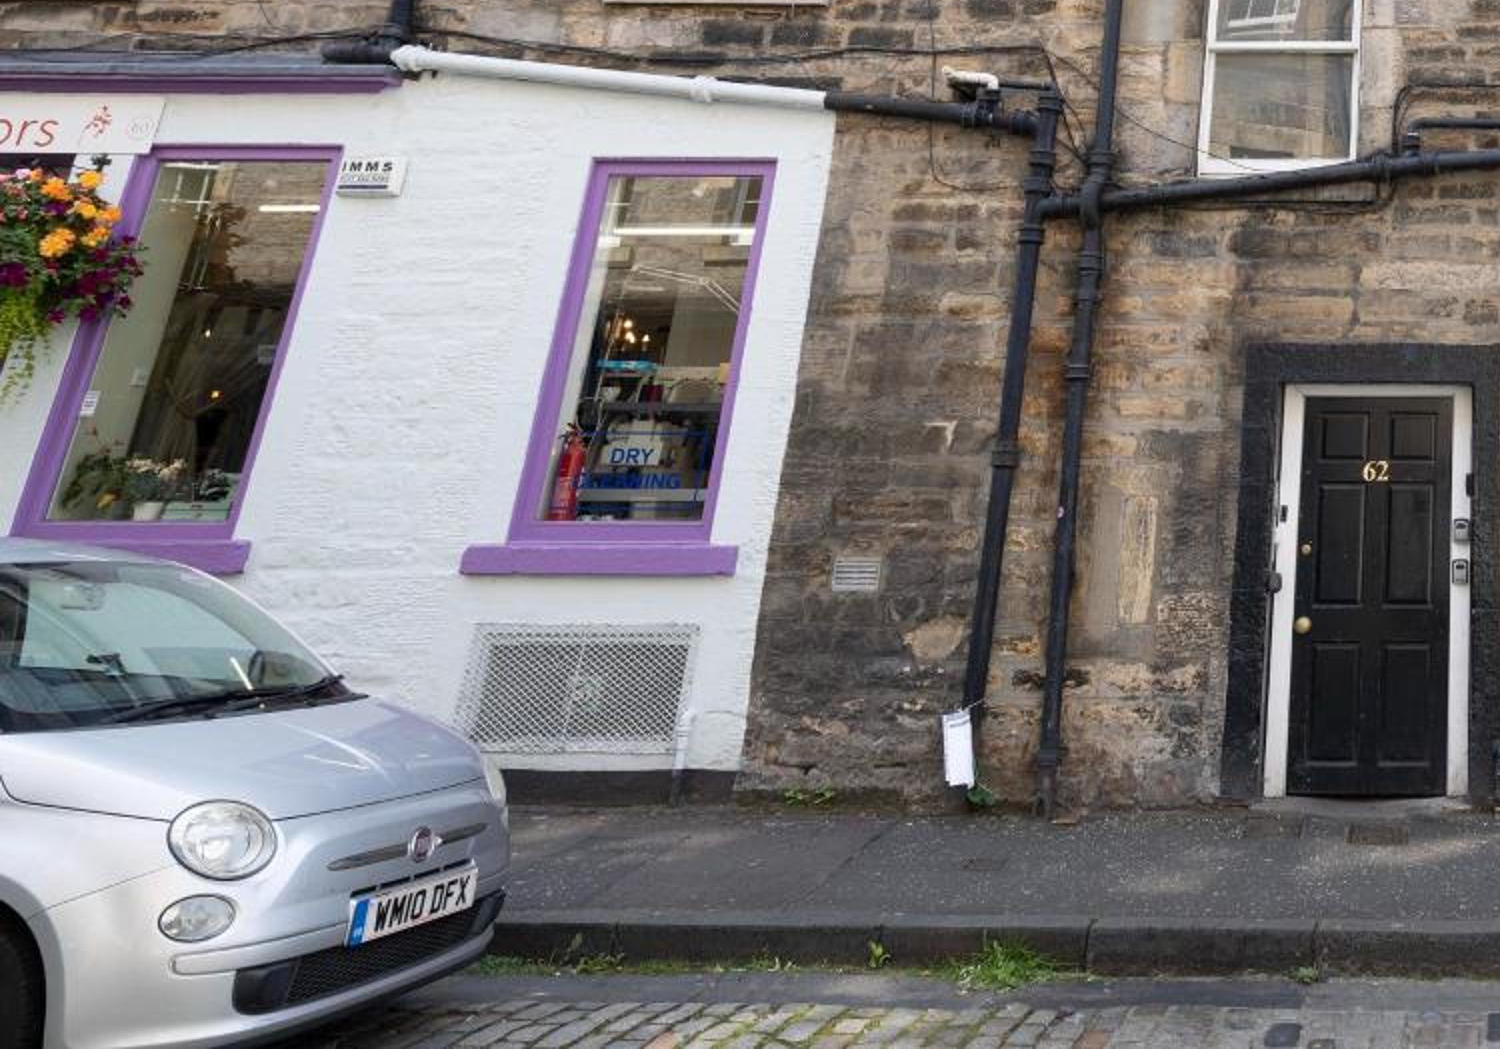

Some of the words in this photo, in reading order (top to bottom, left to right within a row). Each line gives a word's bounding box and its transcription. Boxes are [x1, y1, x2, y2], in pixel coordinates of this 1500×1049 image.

[610, 448, 654, 464] DRY
[1363, 460, 1389, 482] 62
[430, 874, 471, 915] DFX
